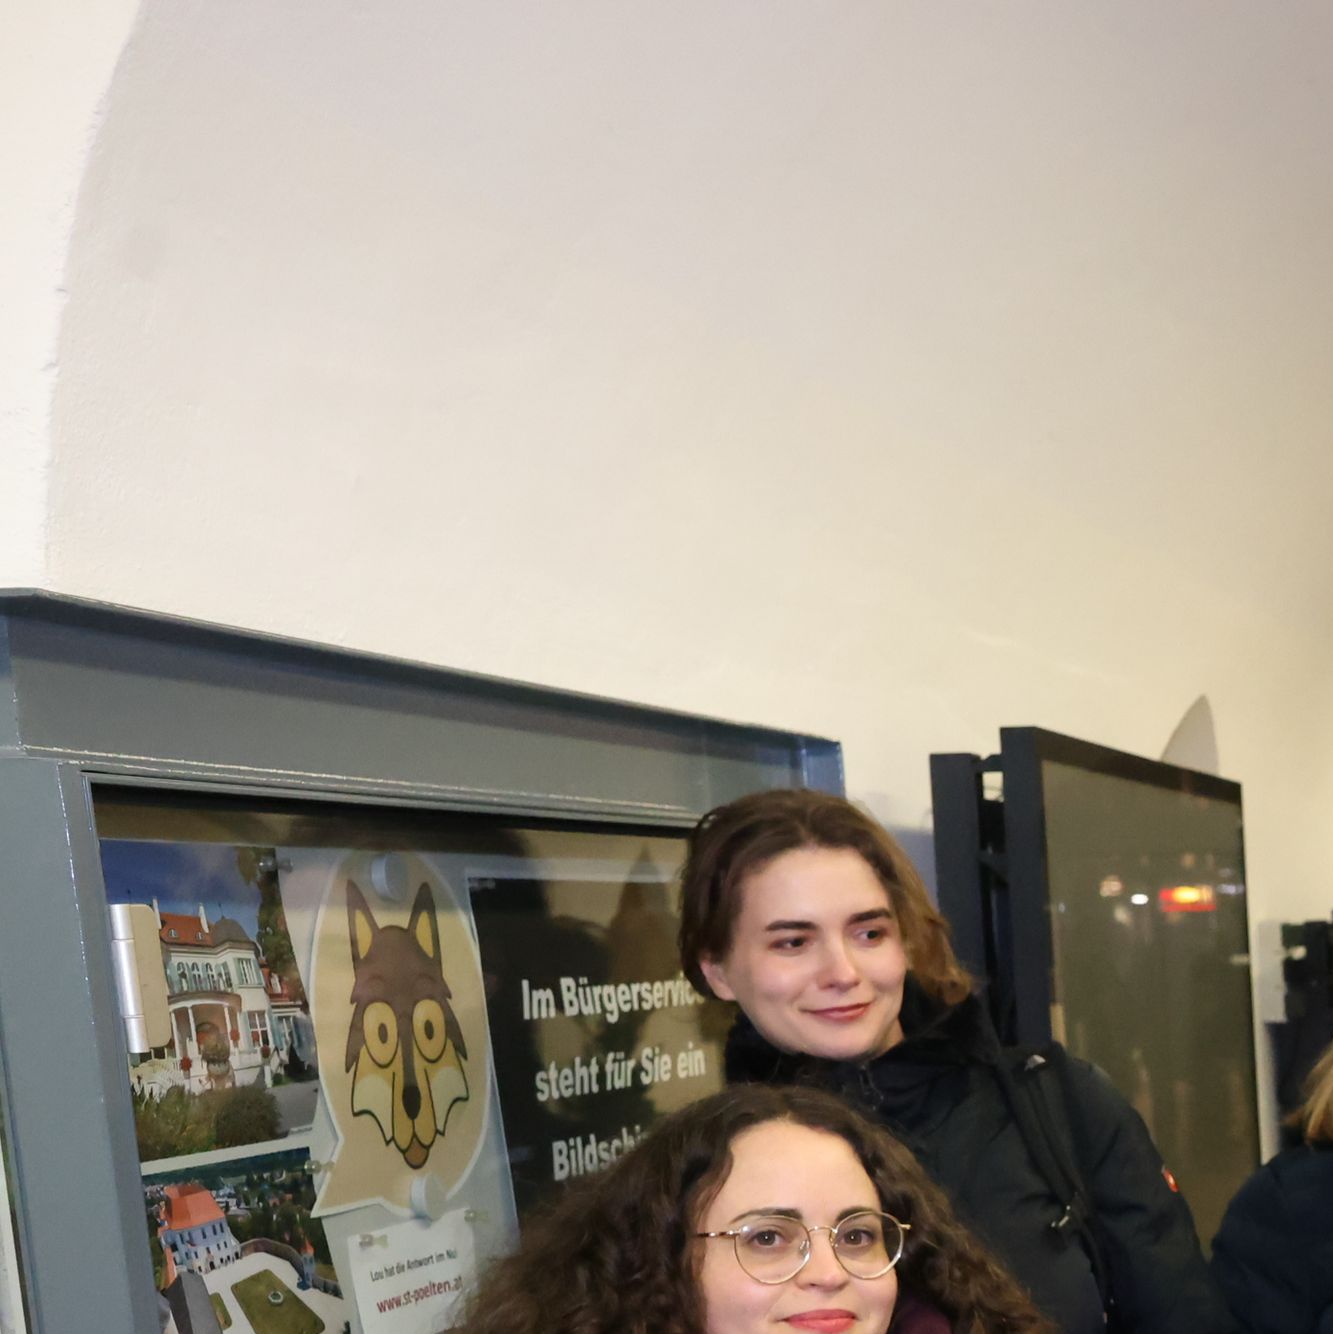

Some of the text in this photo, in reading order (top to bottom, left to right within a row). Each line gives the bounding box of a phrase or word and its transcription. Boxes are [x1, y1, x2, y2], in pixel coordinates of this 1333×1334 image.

[521, 971, 704, 1024] Im Bürgerservic
[535, 1041, 706, 1101] steht für Sie ein
[407, 1254, 435, 1270] Antwort
